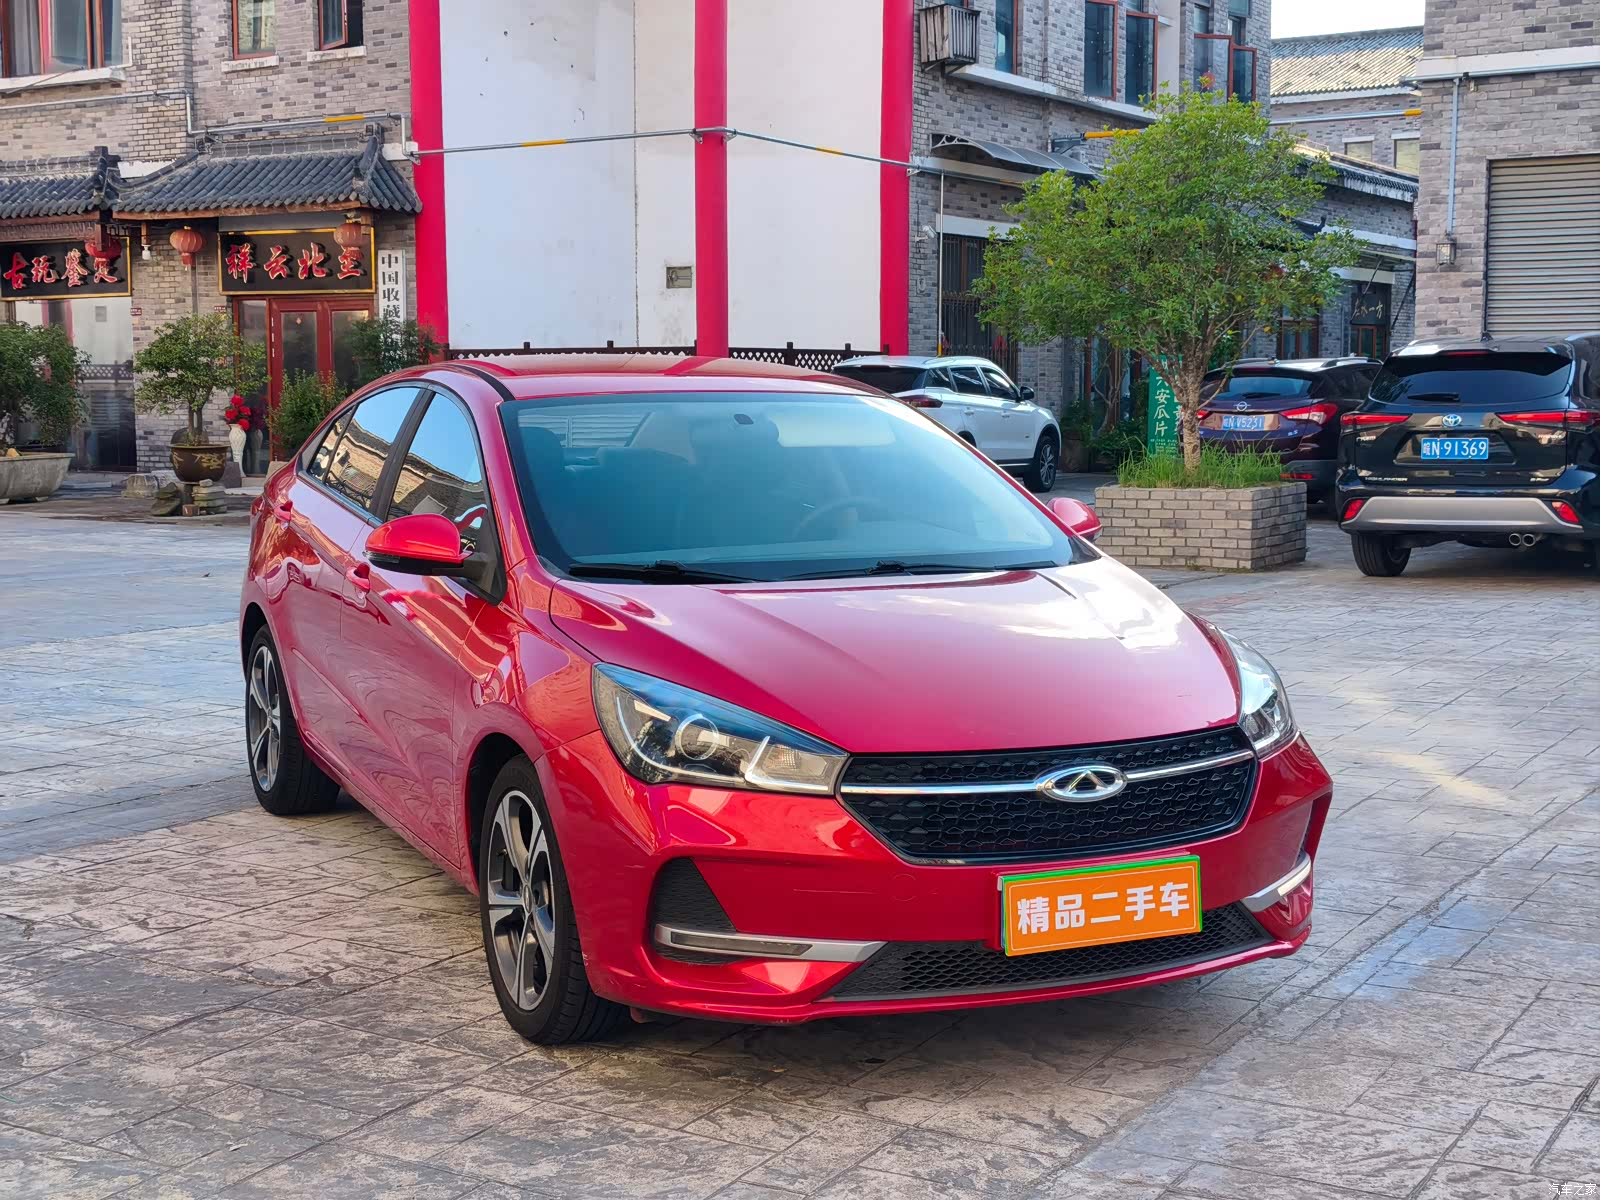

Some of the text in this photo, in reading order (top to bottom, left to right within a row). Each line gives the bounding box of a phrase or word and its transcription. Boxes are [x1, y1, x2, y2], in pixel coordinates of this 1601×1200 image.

[381, 253, 401, 335] 中国收藏
[1153, 375, 1171, 437] 六安瓜片
[1016, 881, 1190, 935] 精品二手车
